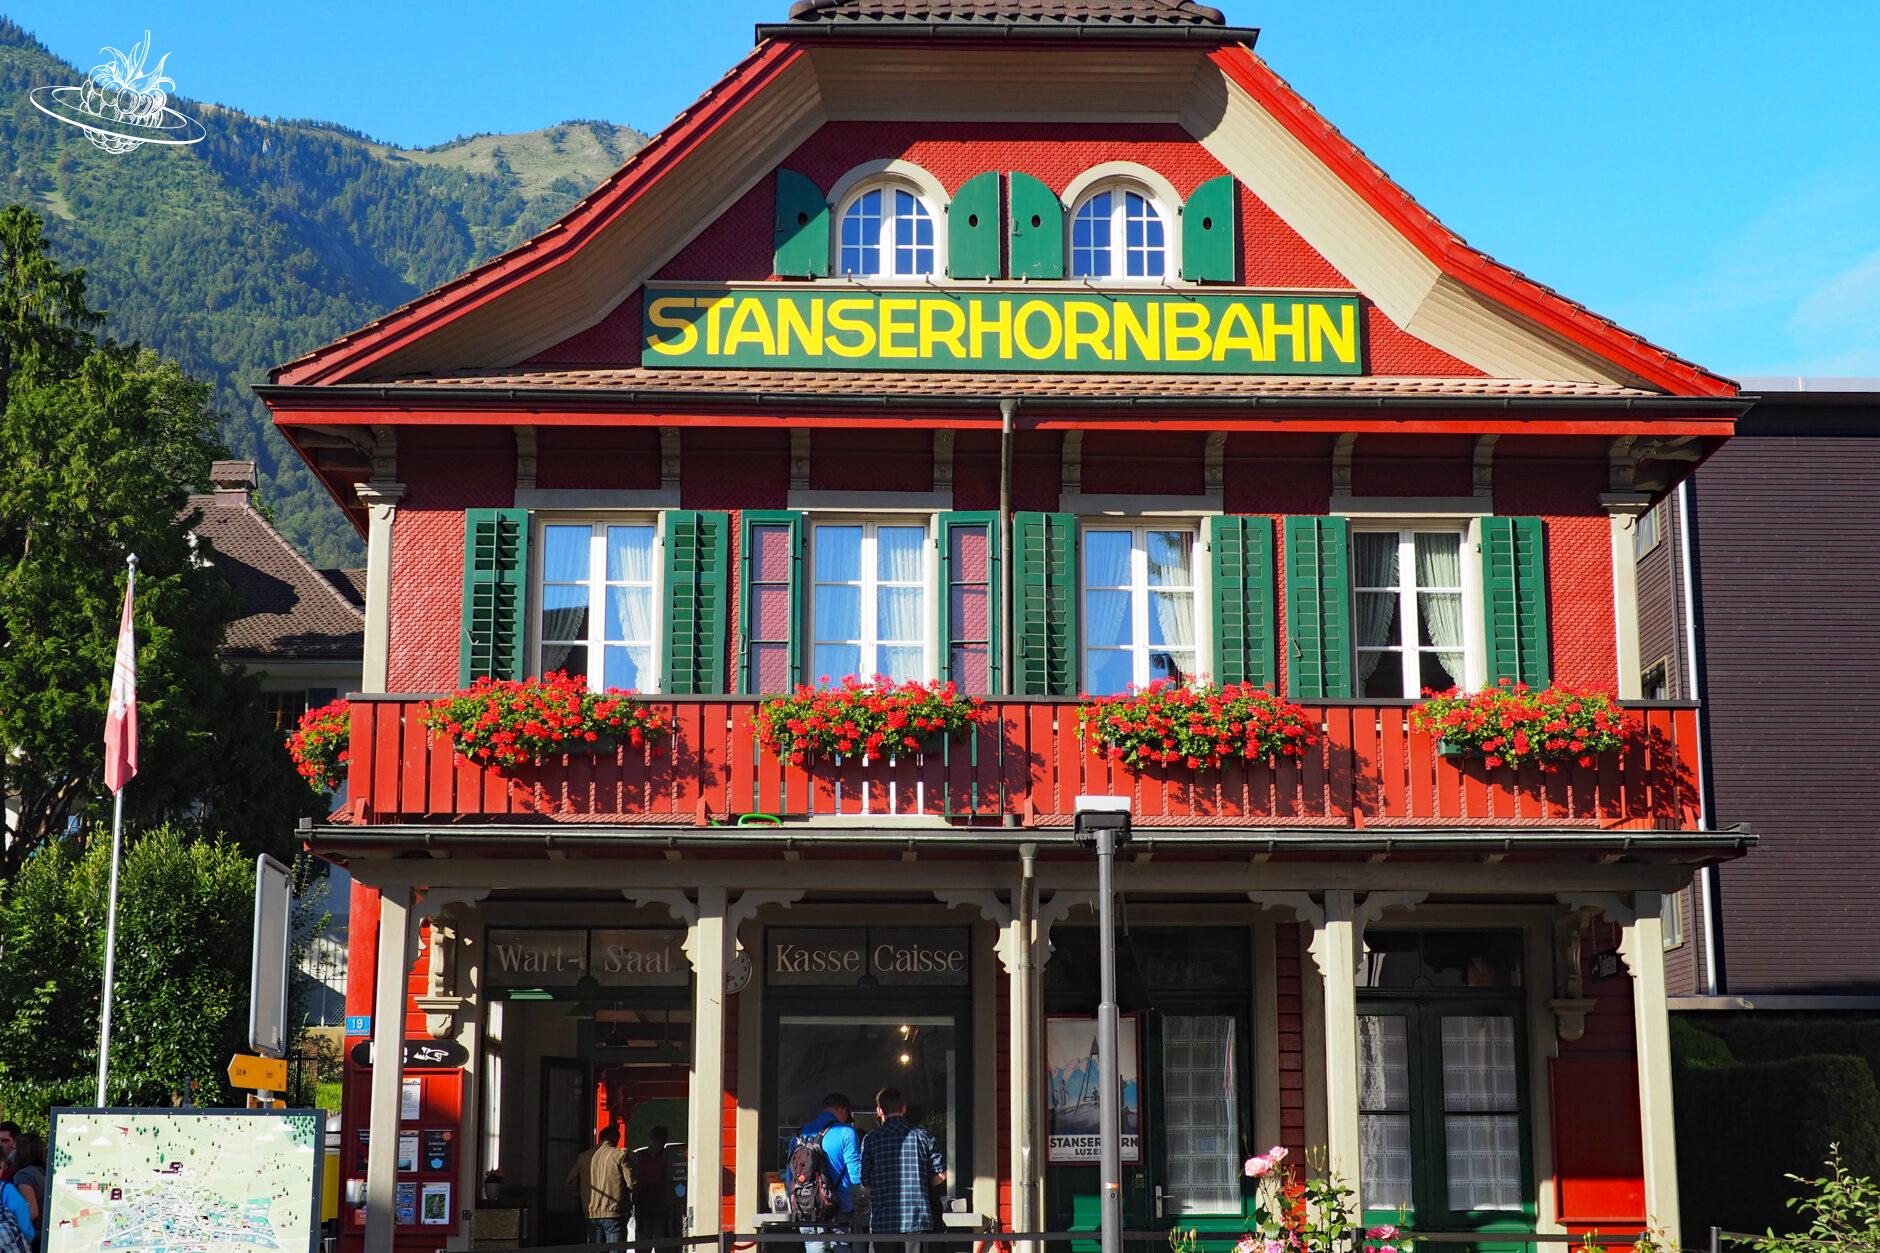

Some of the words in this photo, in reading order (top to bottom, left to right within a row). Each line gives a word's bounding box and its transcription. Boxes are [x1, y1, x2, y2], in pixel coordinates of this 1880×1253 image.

[646, 297, 1356, 363] STANSERHORNBAHN
[604, 945, 671, 972] Saal
[775, 944, 861, 973] Kasse
[873, 944, 965, 973] Caisse
[351, 1018, 364, 1029] 19
[1049, 1137, 1139, 1148] STANSERRN
